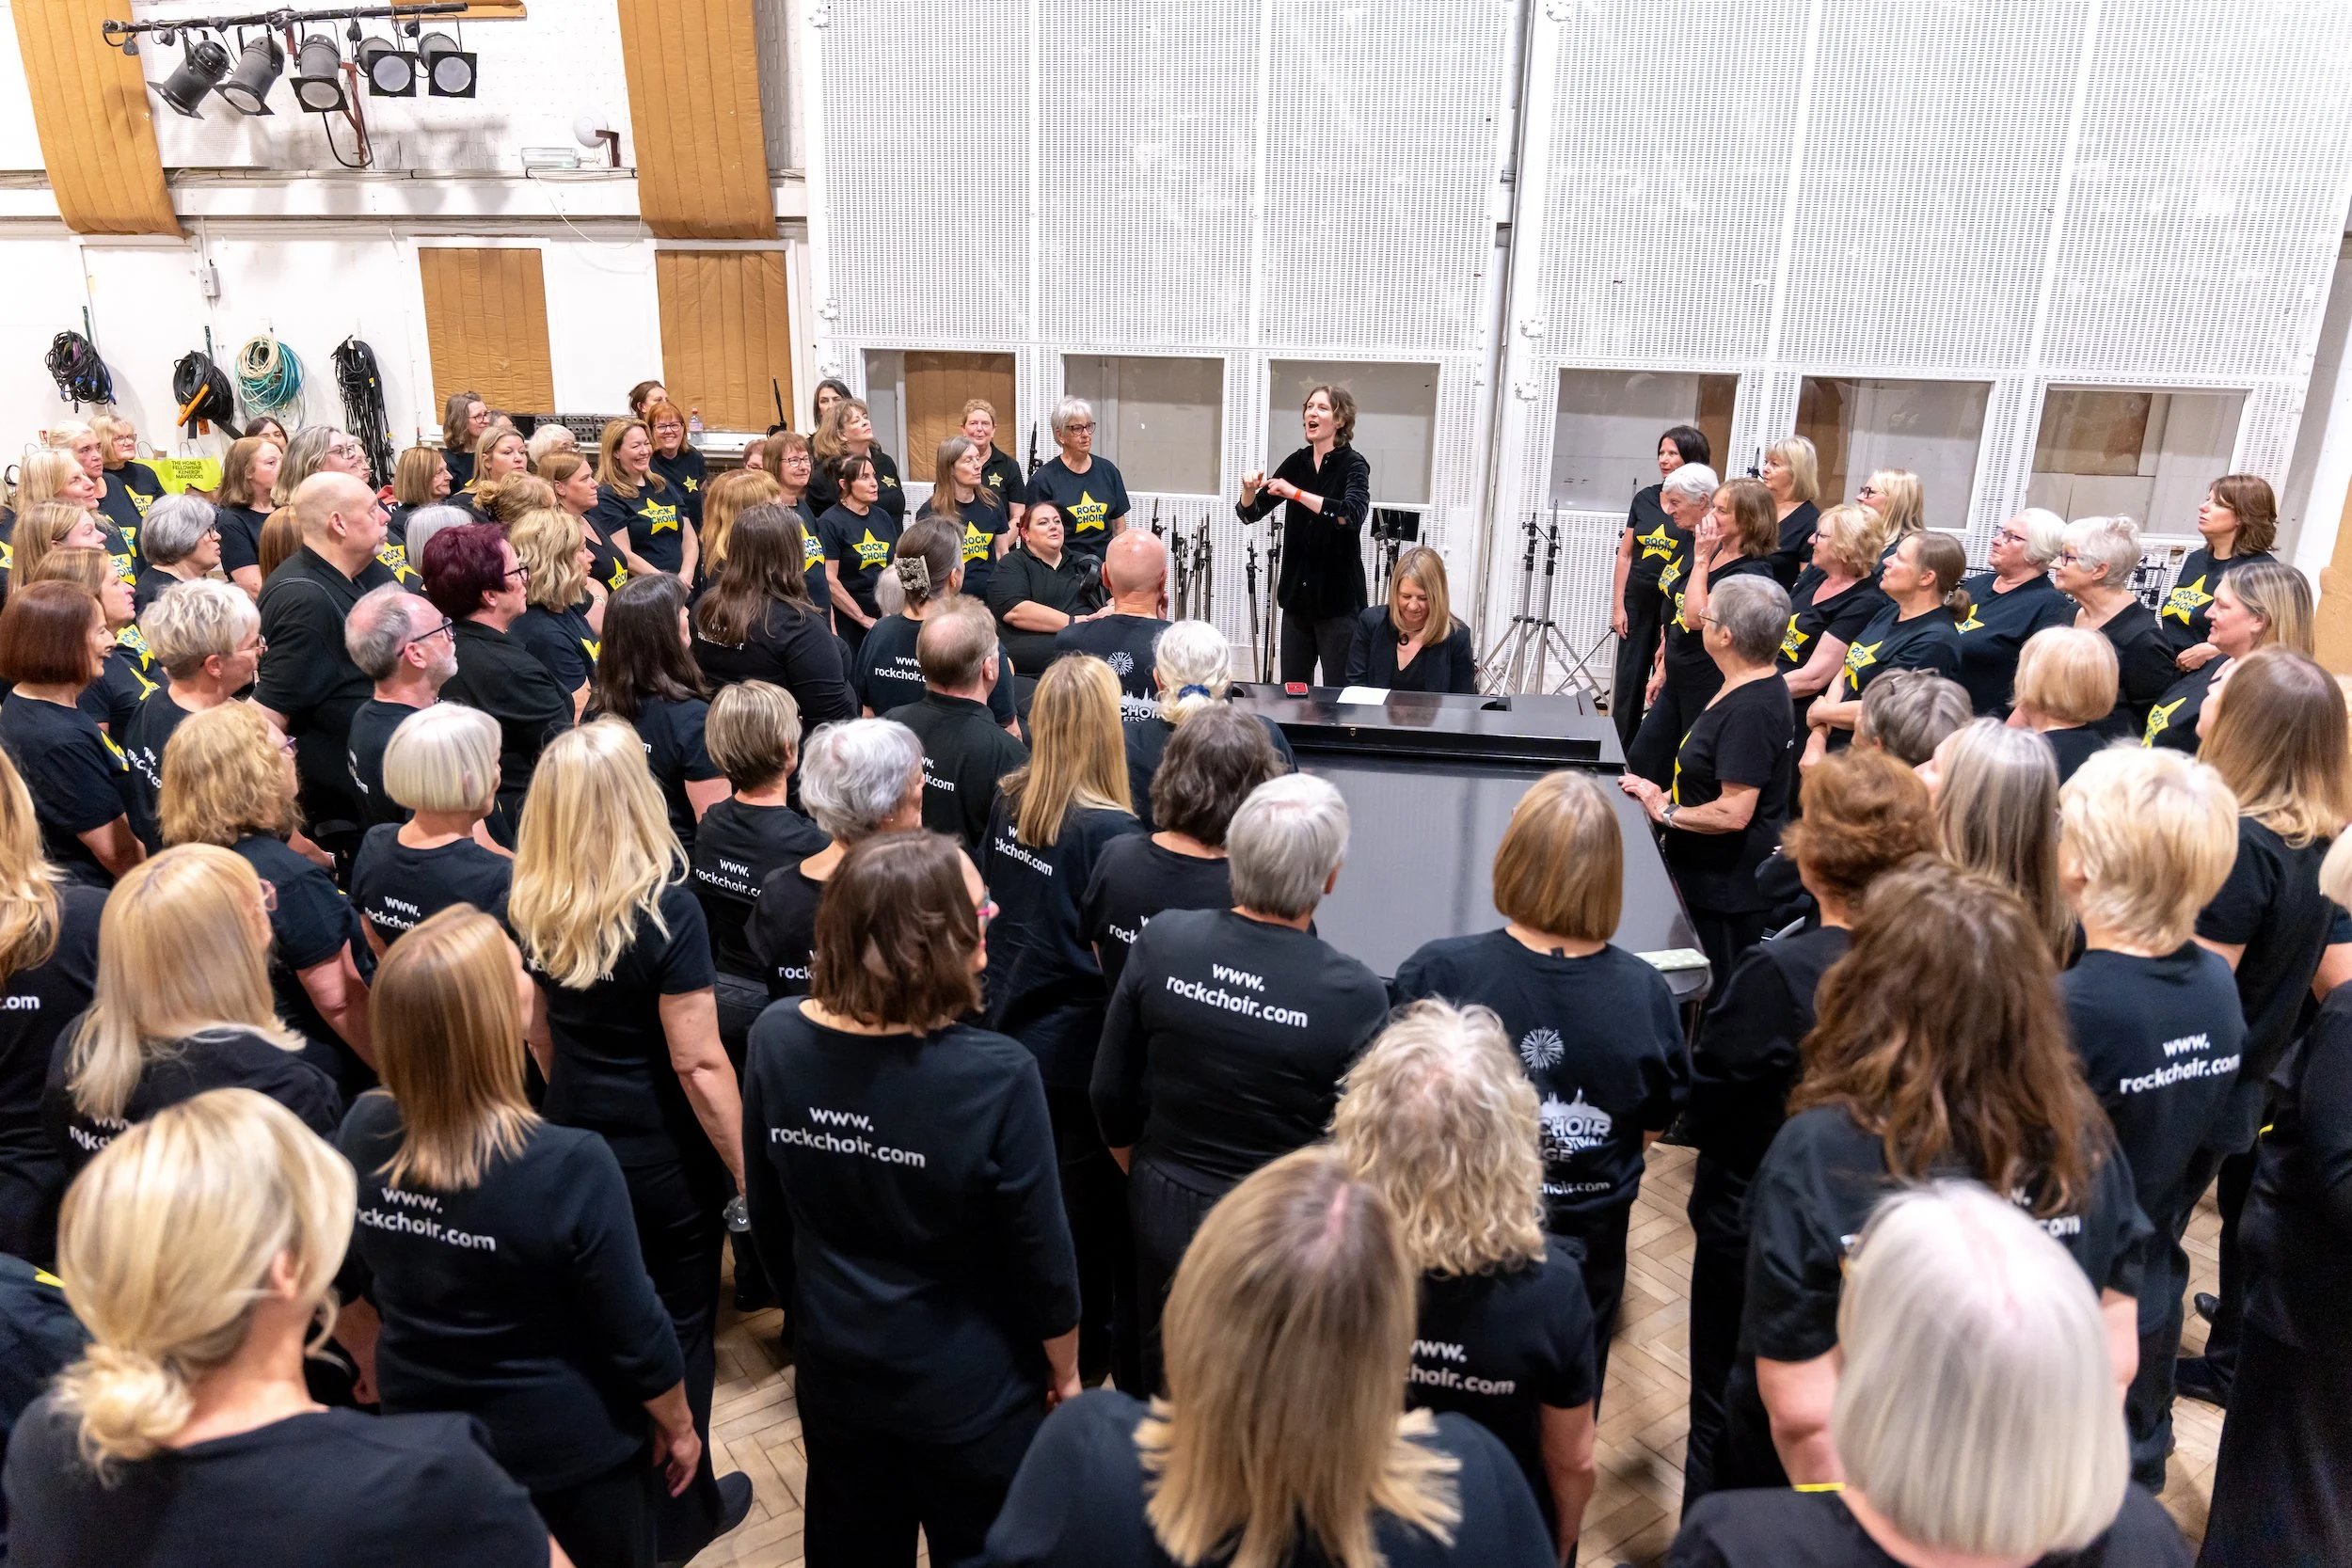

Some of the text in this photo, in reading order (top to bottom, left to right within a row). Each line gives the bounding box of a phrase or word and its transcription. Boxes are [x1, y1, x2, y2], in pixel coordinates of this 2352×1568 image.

[647, 507, 672, 515] ROCK
[1076, 505, 1103, 515] ROCK
[651, 515, 677, 524] CHOIR
[1075, 515, 1105, 524] CHOIR
[861, 543, 884, 552] ROCK
[1645, 537, 1672, 547] ROCK
[383, 548, 401, 562] ROCK
[862, 551, 888, 562] CHOIR
[2175, 590, 2203, 604] ROCK
[2167, 599, 2197, 613] CHOIR
[875, 667, 927, 683] rockchoir.c
[719, 858, 750, 878] www.
[384, 895, 421, 918] www.
[1212, 963, 1265, 992] www.
[1166, 975, 1309, 1028] rockchoir.com
[2162, 1032, 2211, 1058] www.
[808, 1106, 875, 1132] www.
[770, 1127, 926, 1168] rockchoir.com
[381, 1186, 443, 1214] www.
